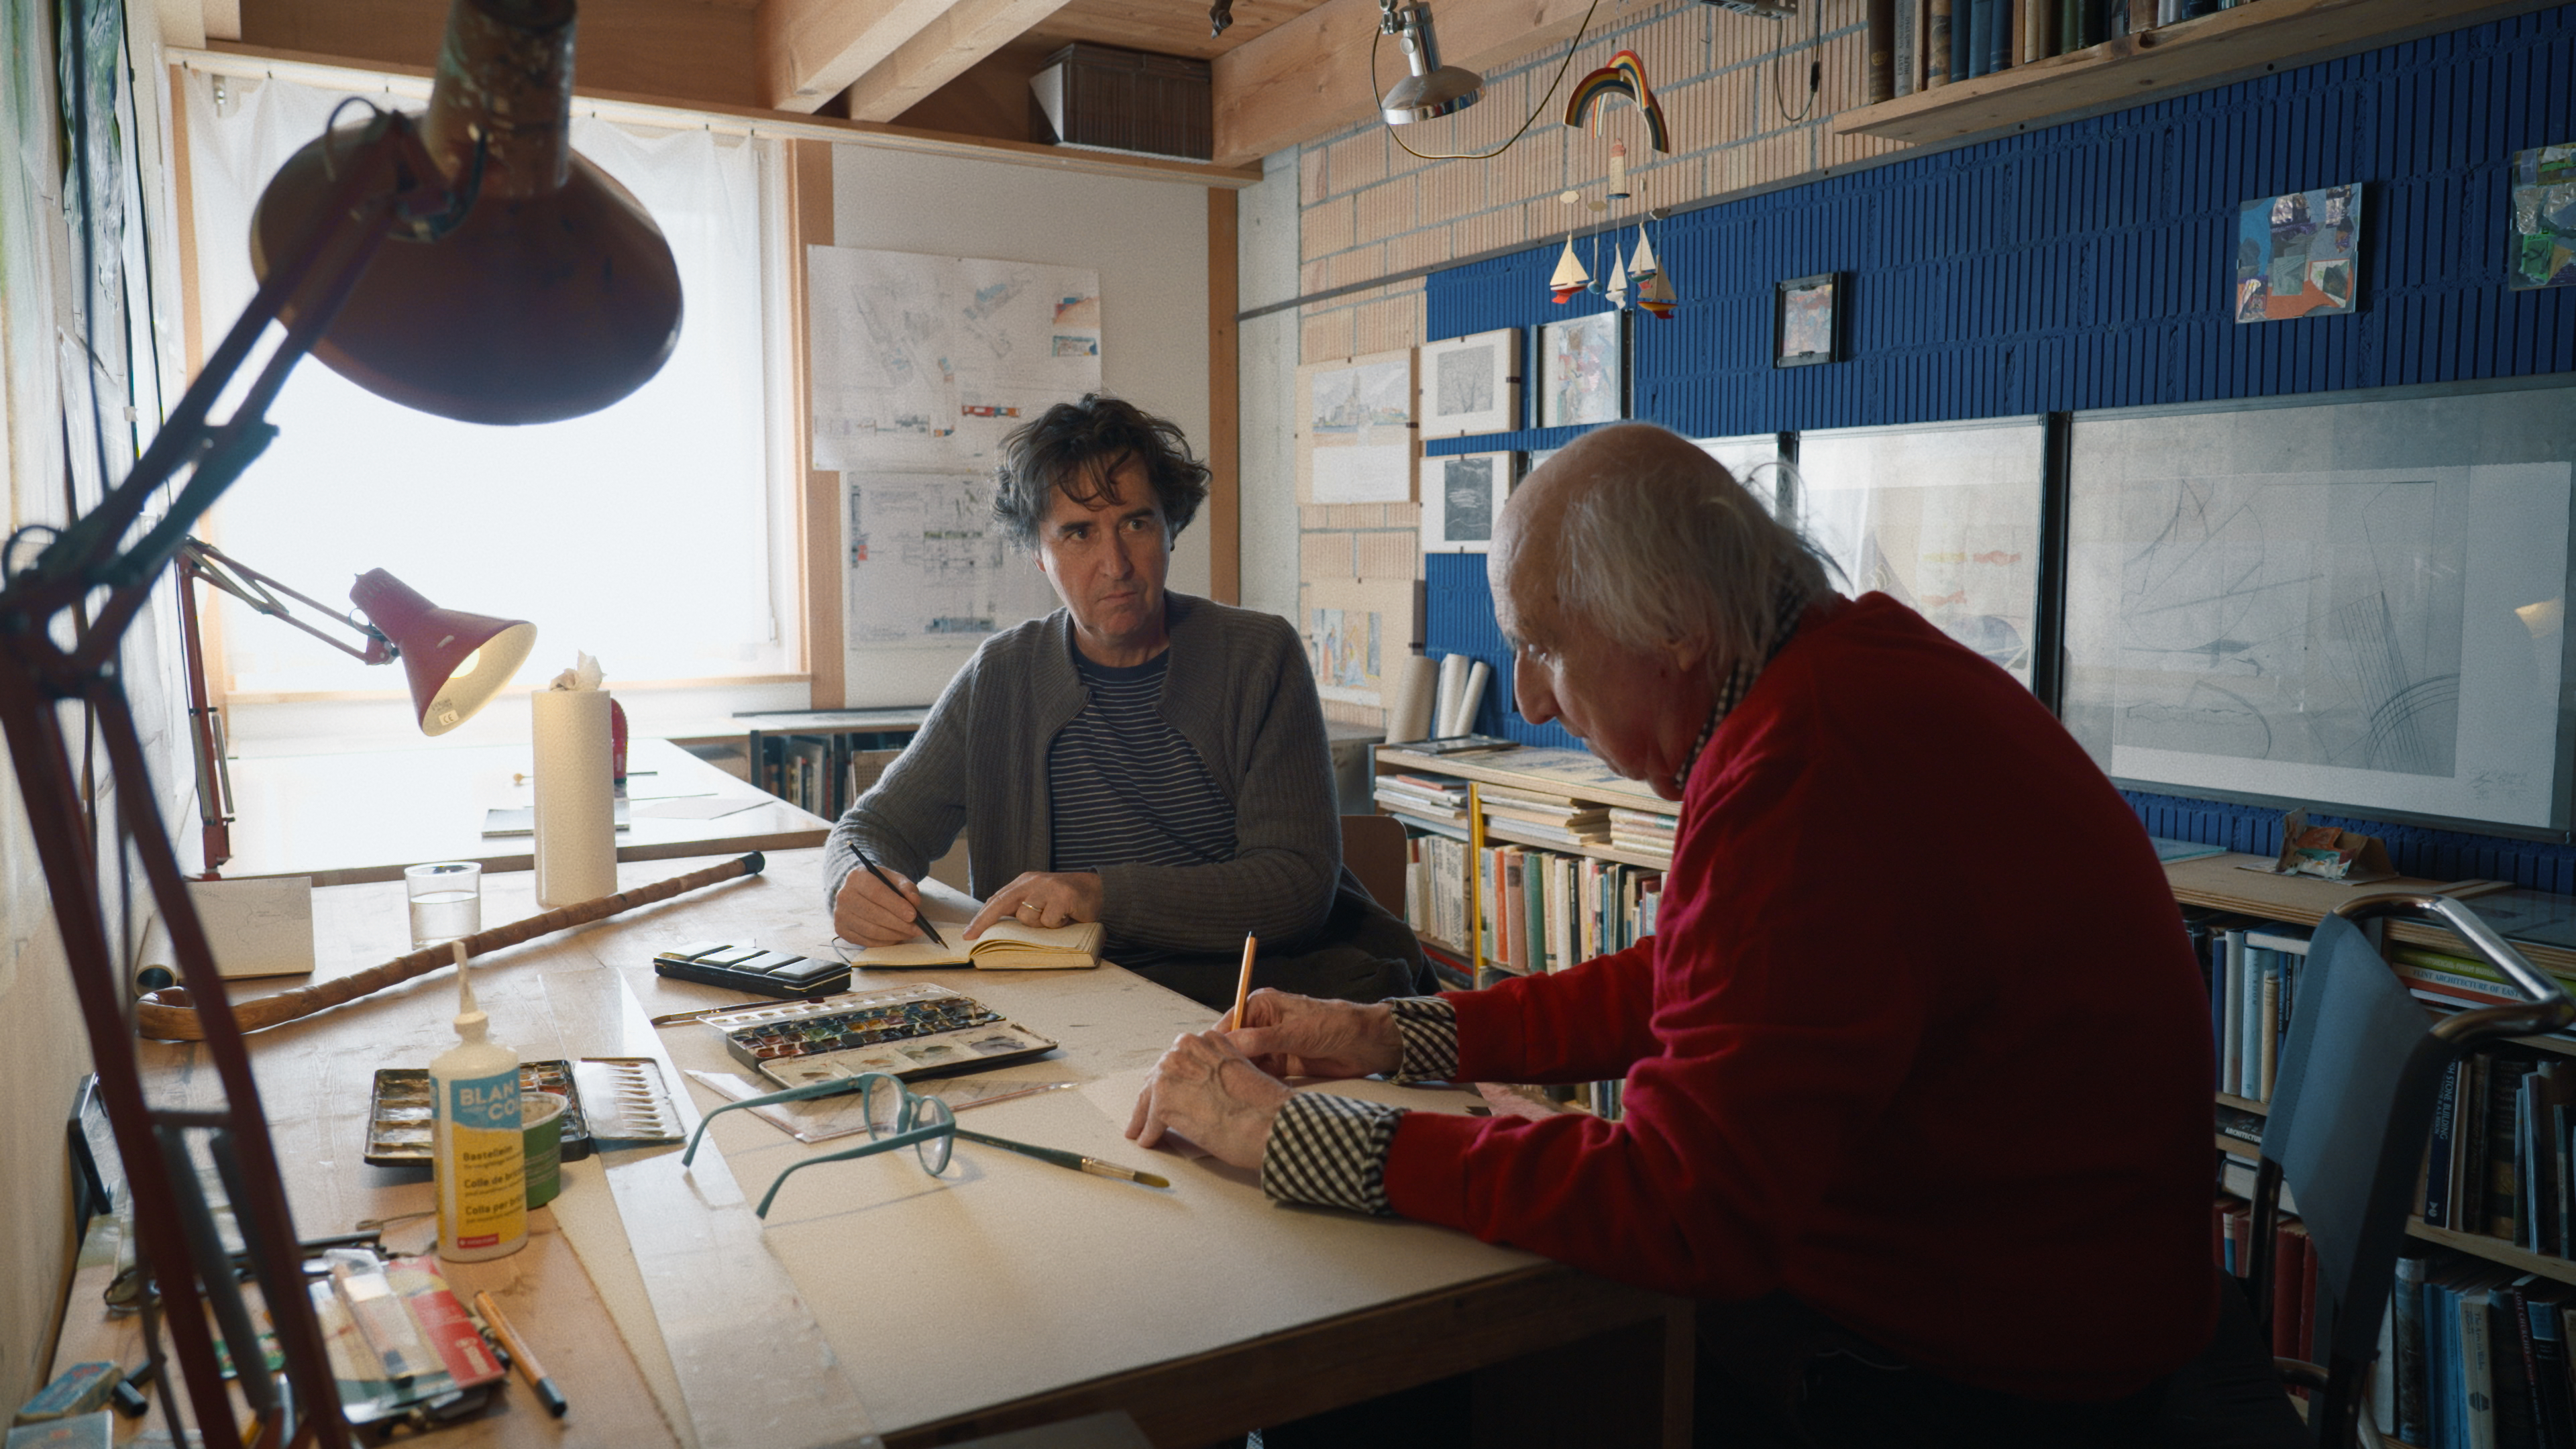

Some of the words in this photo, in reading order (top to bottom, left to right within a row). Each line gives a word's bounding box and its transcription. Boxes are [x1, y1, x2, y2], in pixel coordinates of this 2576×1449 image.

[2413, 970, 2432, 980] FLINT
[2434, 973, 2488, 991] ARCHITECTURE
[2489, 983, 2500, 993] OF
[460, 1080, 515, 1106] BLAN
[2443, 1075, 2455, 1102] STONE
[2439, 1103, 2452, 1140] BUILDING
[2224, 1126, 2263, 1143] ARCHITECTUR
[464, 1178, 489, 1189] Colle
[492, 1176, 503, 1185] de
[466, 1205, 490, 1216] Colla
[493, 1201, 509, 1214] per
[2515, 1291, 2524, 1311] LOST
[2518, 1312, 2531, 1354] CHURCHES
